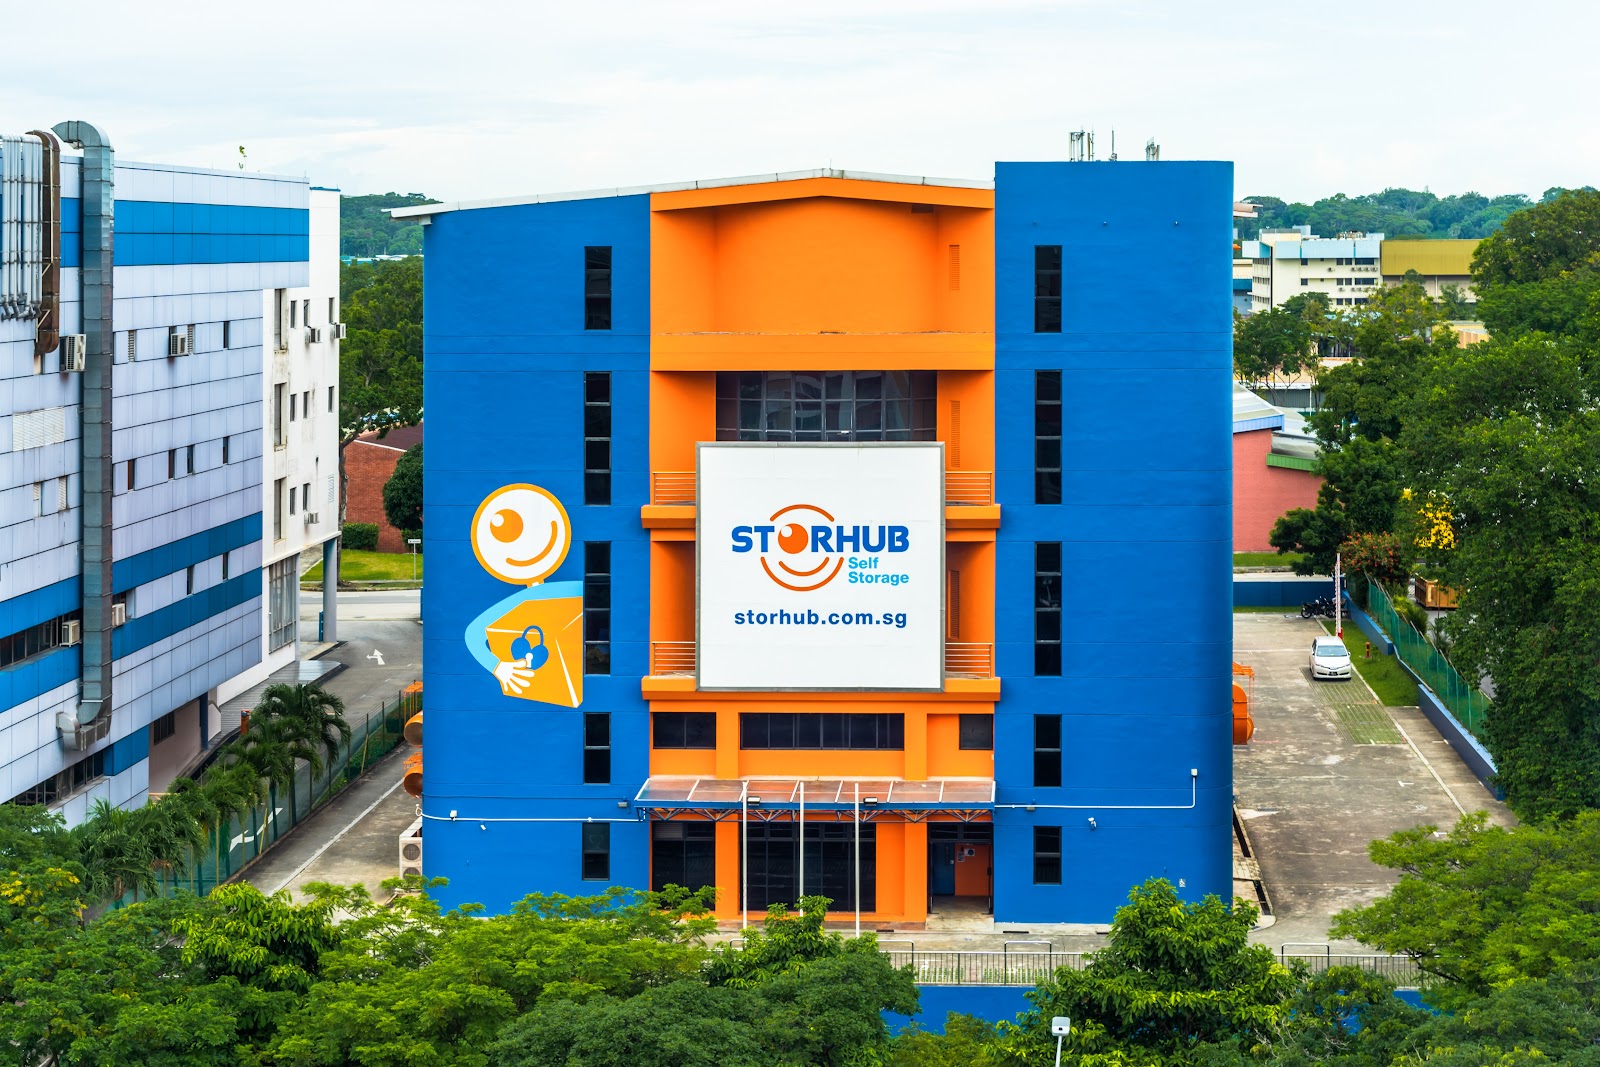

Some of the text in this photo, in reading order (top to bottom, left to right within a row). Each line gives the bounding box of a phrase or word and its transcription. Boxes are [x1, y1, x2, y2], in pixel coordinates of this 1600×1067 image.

[731, 524, 909, 553] STORHUB
[848, 557, 879, 569] Self
[848, 571, 909, 586] Storage
[734, 609, 907, 628] storhub.com.sg
